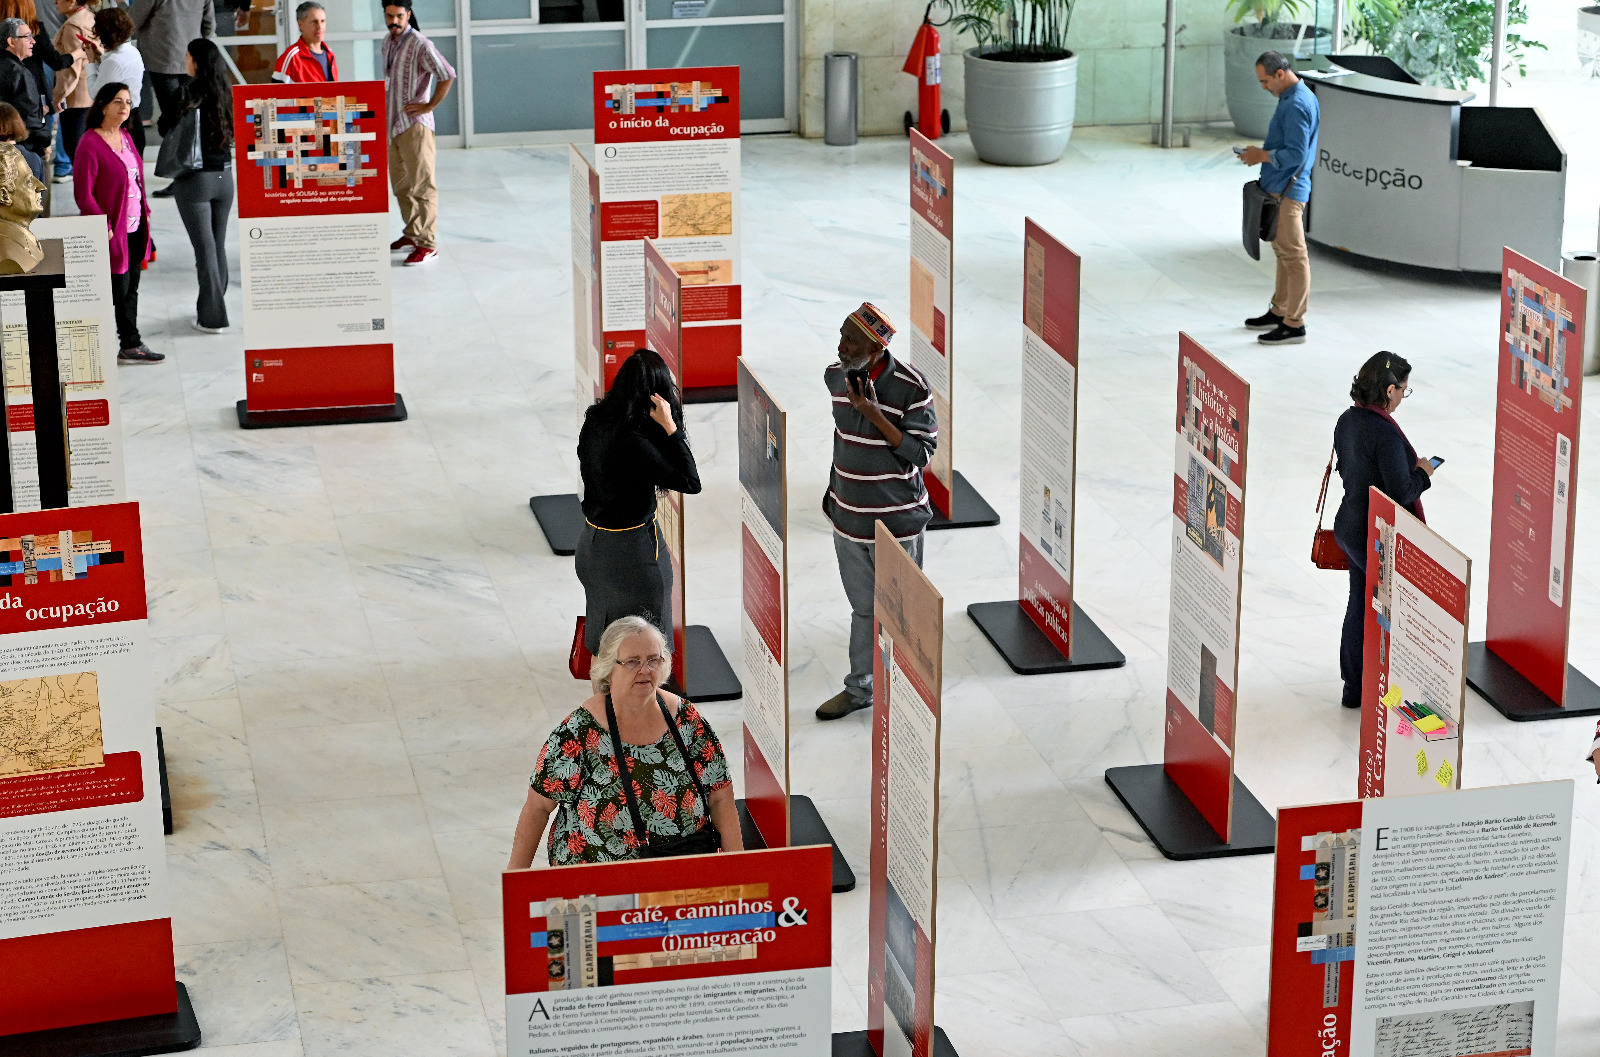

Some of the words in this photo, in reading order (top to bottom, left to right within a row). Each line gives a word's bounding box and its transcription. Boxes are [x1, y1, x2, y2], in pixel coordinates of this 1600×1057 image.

[620, 118, 652, 128] início
[655, 116, 669, 127] da
[670, 123, 724, 137] ocupação
[1319, 149, 1423, 190] Recepção
[1521, 305, 1541, 323] CRÉDITOS
[1198, 382, 1225, 419] histórias
[1209, 418, 1213, 431] a
[1215, 417, 1239, 453] história
[26, 597, 120, 622] ocupação
[1023, 586, 1045, 617] políticas
[1046, 610, 1068, 643] públicas
[1039, 587, 1061, 614] construção
[1061, 605, 1068, 622] de
[1424, 823, 1455, 831] inaugurada
[1372, 852, 1405, 860] Monjolinho
[1420, 839, 1453, 848] proprietário
[1348, 852, 1356, 901] CARPINTARIA
[621, 905, 669, 925] café,
[675, 898, 773, 920] caminhos
[777, 896, 808, 928] &
[585, 920, 594, 971] CARPINTARIA
[661, 927, 776, 953] (i)migração
[528, 998, 550, 1022] A
[554, 995, 583, 1004] produção
[609, 991, 632, 1000] ganhou
[651, 987, 675, 995] impulso
[762, 976, 795, 984] construção
[703, 990, 736, 999] imigrantes
[744, 987, 776, 995] migrantes.
[1453, 983, 1496, 992] comercializado
[620, 1005, 653, 1014] inaugurada
[707, 997, 745, 1005] conectando,
[528, 1022, 551, 1030] Estação
[600, 1015, 637, 1023] Cosmópolis,
[639, 1012, 667, 1021] passando
[669, 1011, 684, 1019] pelas
[686, 1008, 712, 1016] fazendas
[558, 1027, 589, 1035] facilitando
[597, 1023, 637, 1032] comunicação
[651, 1019, 681, 1027] transporte
[692, 1016, 719, 1025] produtos
[736, 1013, 759, 1021] pessoas.
[560, 1044, 588, 1052] seguidos
[600, 1040, 640, 1049] portugueses,
[643, 1036, 674, 1045] espanhóis
[734, 1028, 763, 1037] principais
[765, 1025, 795, 1034] imigrantes
[596, 1049, 612, 1057] partir
[720, 1037, 752, 1046] população
[776, 1032, 806, 1040] sobretudo
